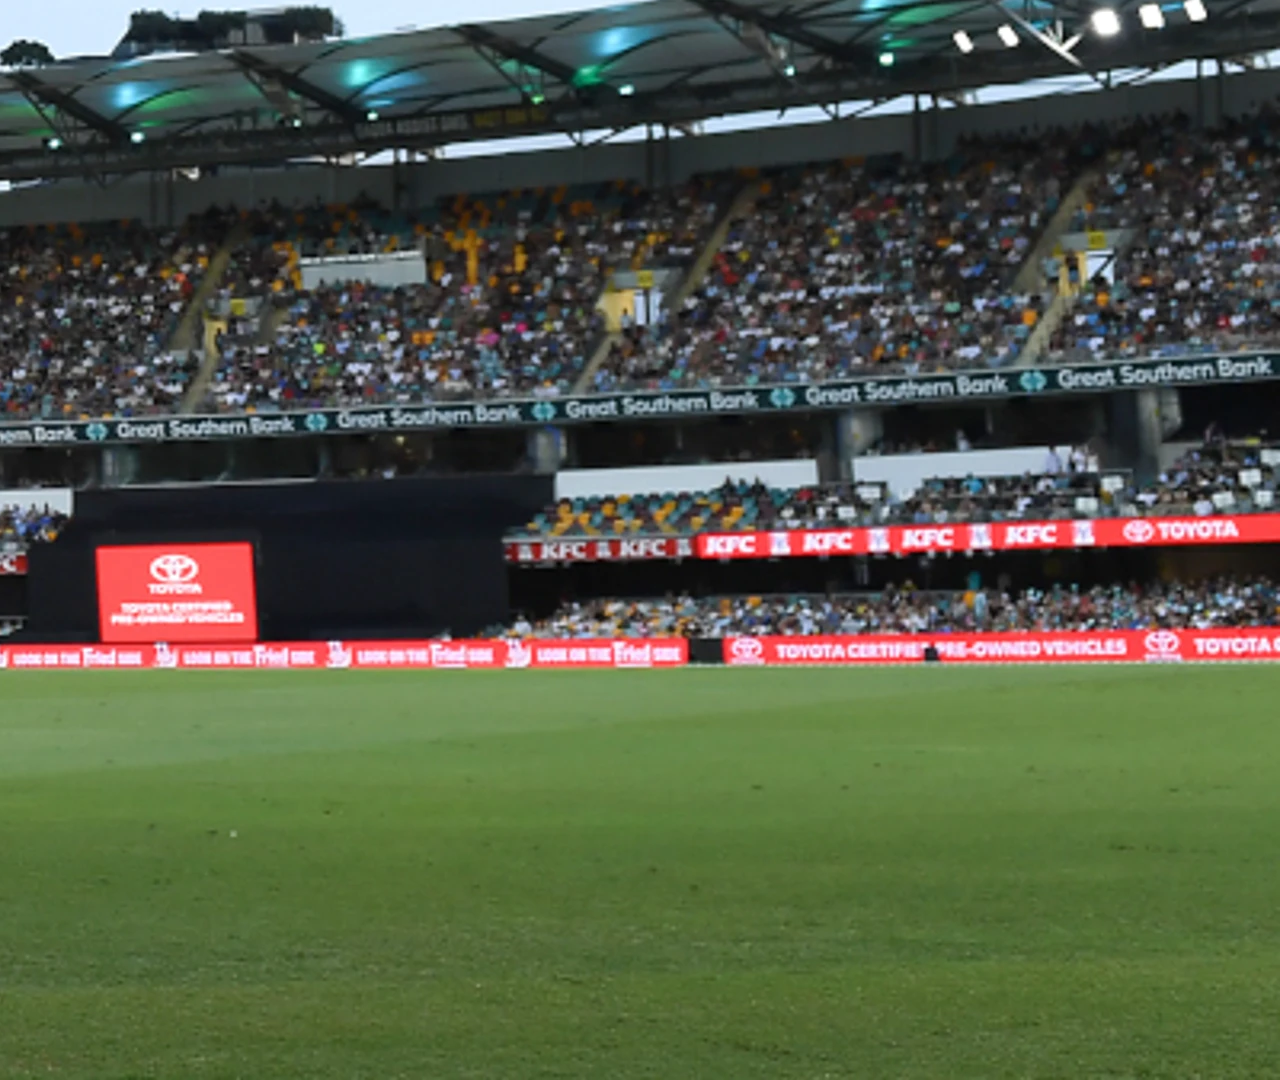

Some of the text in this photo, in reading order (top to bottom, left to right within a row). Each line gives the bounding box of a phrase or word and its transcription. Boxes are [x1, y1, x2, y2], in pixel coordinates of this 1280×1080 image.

[1058, 355, 1273, 389] Great Southern Bank
[805, 373, 1009, 406] Great Southern Bank
[565, 388, 760, 417] Great Southern Bank
[337, 401, 523, 428] Great Southern Bank
[34, 420, 77, 440] Bank
[116, 412, 295, 439] Great Southern Bank
[902, 529, 953, 547] KFC
[1006, 525, 1056, 544] KFC
[1157, 521, 1238, 539] TOYOTA
[542, 542, 585, 559] KFC
[621, 539, 665, 556] KFC
[707, 536, 755, 554] KFC
[804, 532, 852, 551] KFC
[149, 583, 202, 594] TOYOTA
[119, 601, 171, 614] TOYOTA
[776, 643, 845, 660] TOYOTA
[936, 639, 1042, 659] PRE-OWNED
[1042, 636, 1128, 656] VEHICLES
[1193, 635, 1273, 657] TOYOTA
